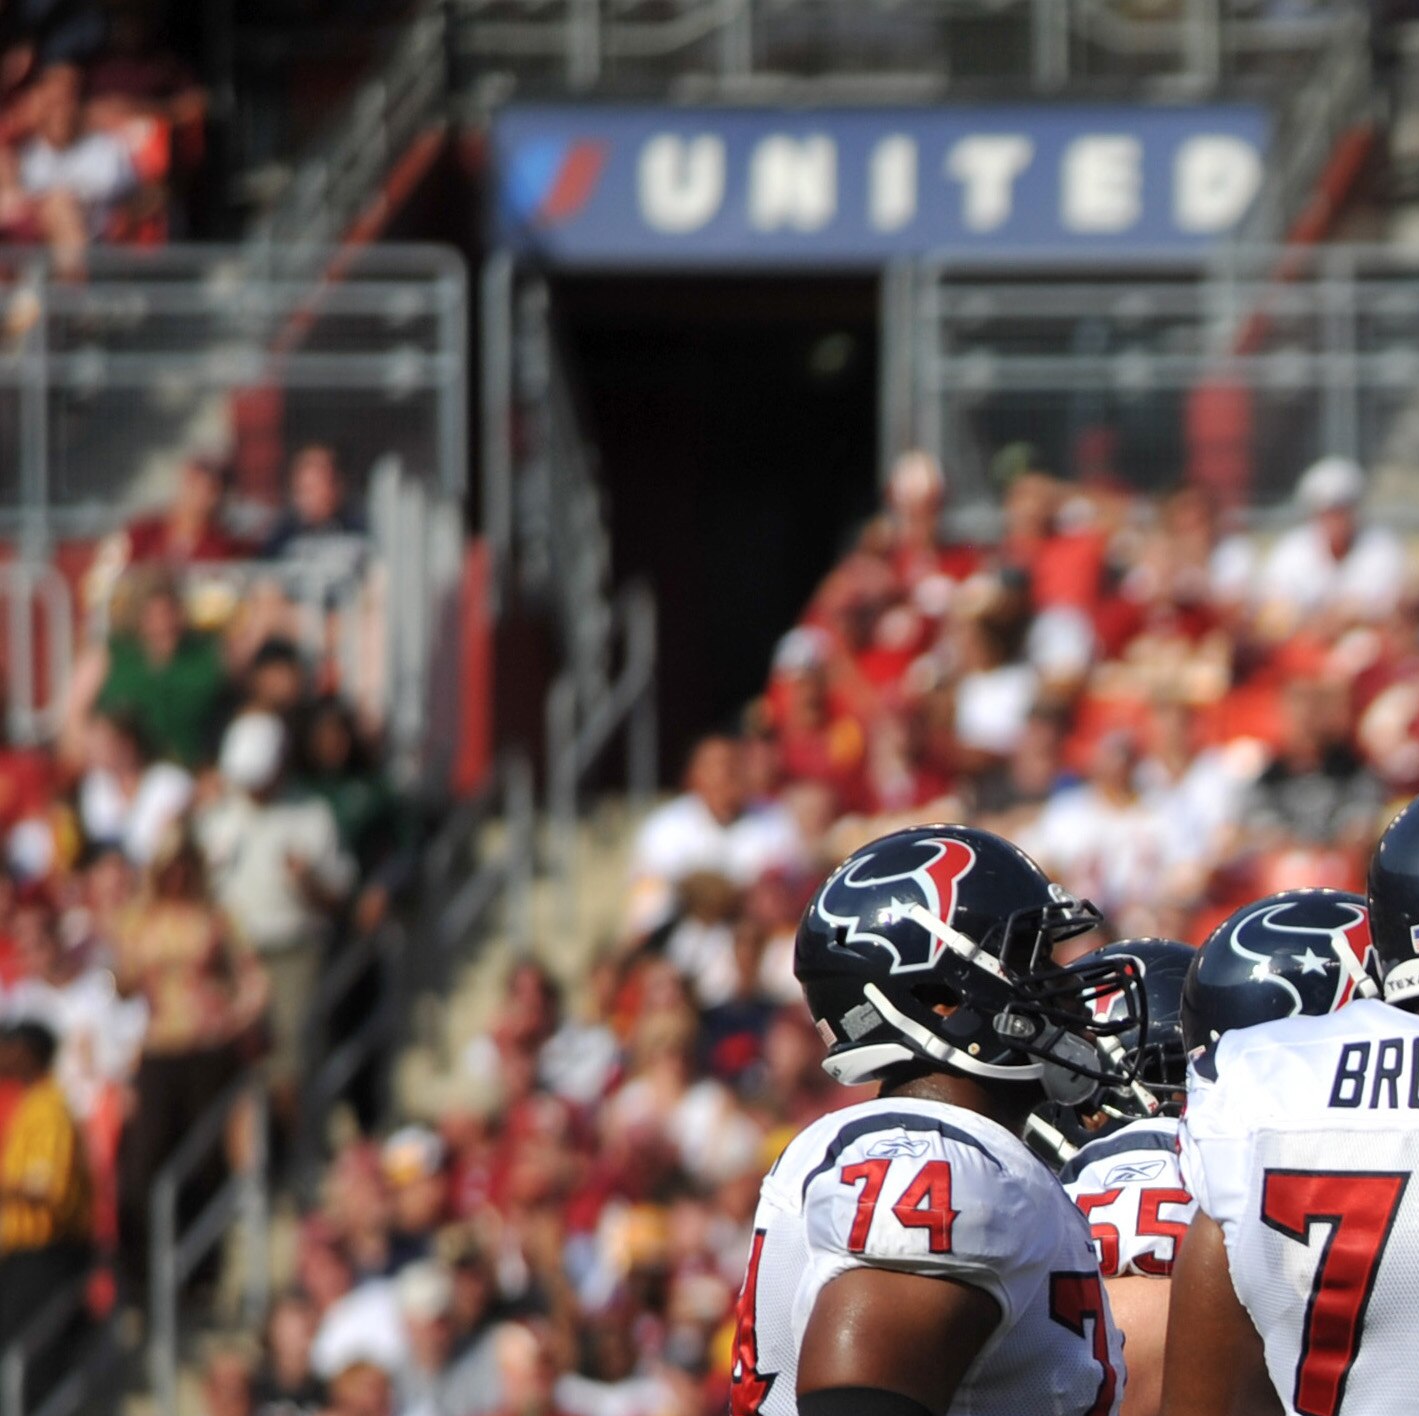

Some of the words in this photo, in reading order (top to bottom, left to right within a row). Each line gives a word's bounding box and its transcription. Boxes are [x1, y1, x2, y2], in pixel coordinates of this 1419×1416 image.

[637, 129, 1264, 235] UNITED
[840, 1158, 960, 1254] 74
[1075, 1187, 1194, 1278] 55
